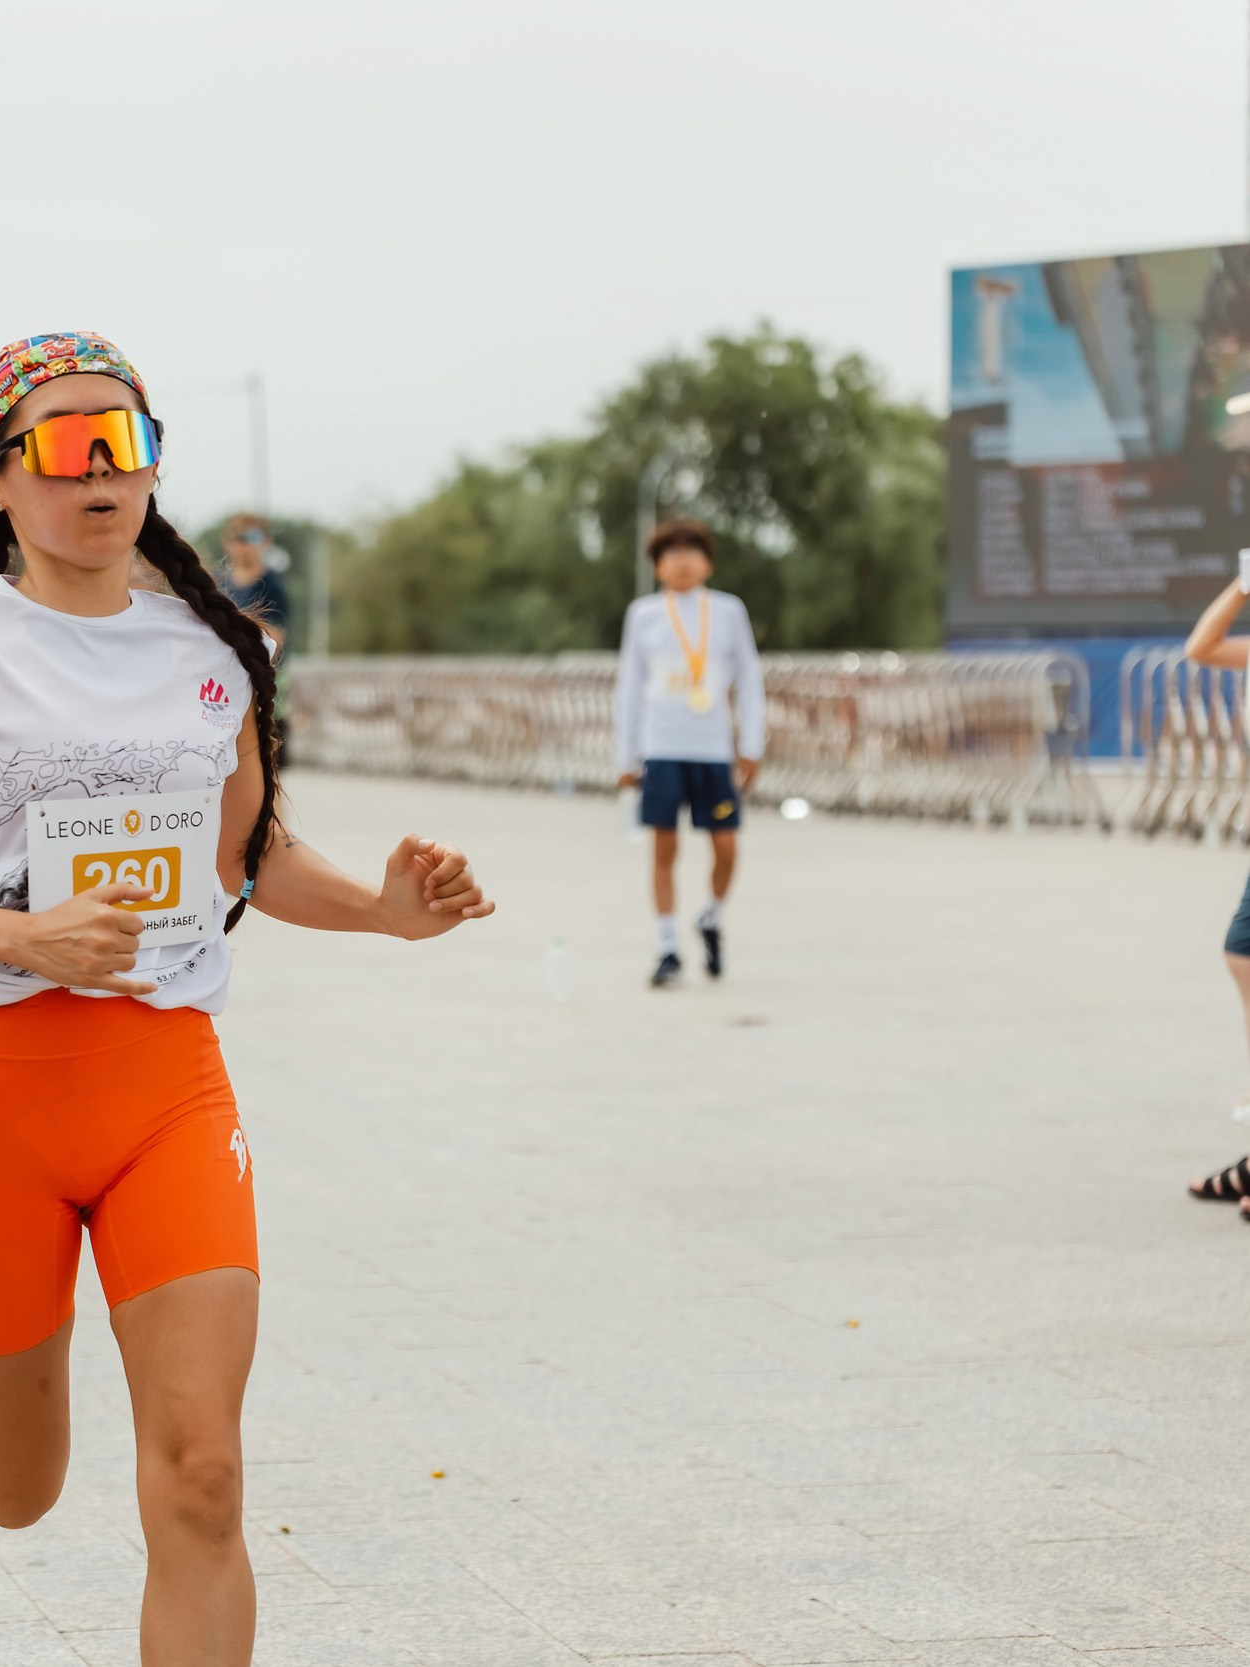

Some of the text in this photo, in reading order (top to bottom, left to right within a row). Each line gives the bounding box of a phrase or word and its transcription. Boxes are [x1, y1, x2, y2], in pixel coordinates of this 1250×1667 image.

[46, 810, 203, 839] LEONE D'ORO
[84, 856, 170, 905] 260
[143, 914, 198, 931] НЫЙ ЗАБЕГ
